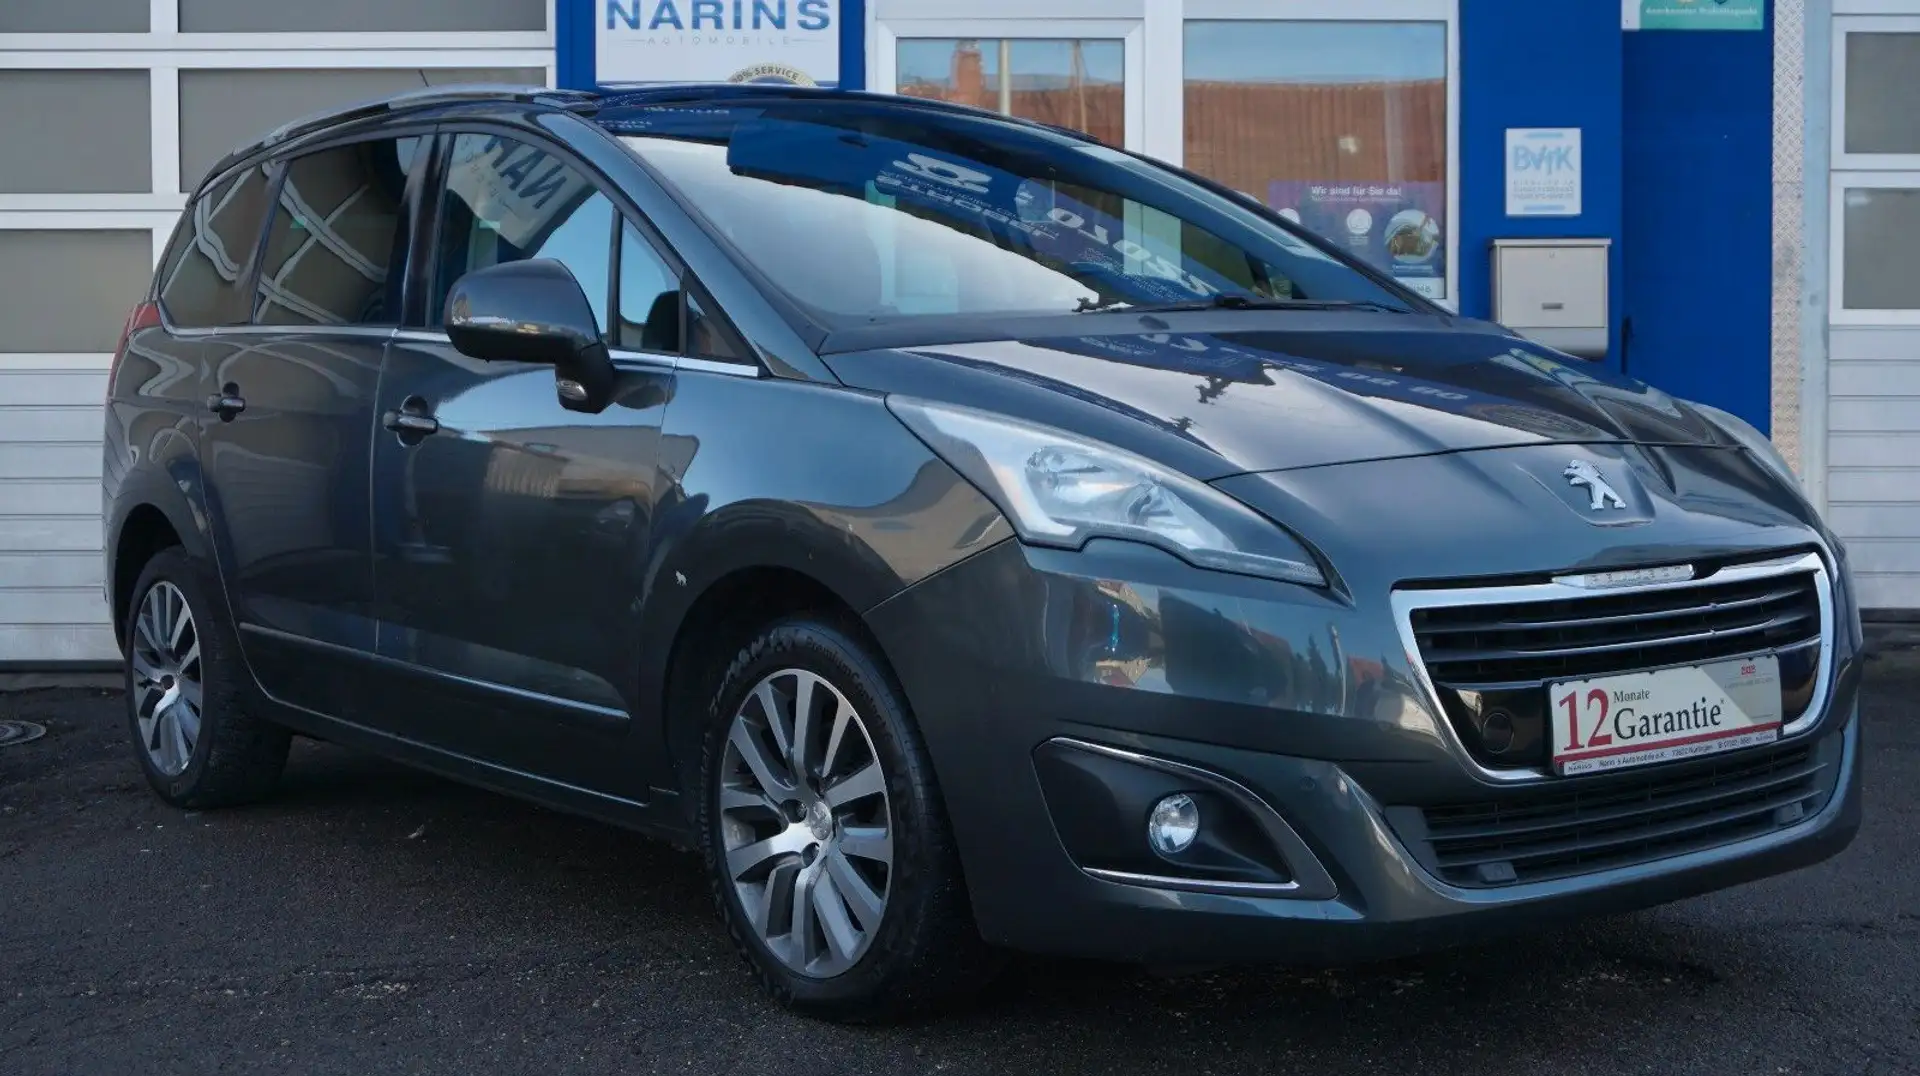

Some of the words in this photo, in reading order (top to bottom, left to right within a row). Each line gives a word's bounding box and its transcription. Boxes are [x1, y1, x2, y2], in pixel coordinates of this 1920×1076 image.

[606, 0, 831, 30] NARINS
[647, 36, 791, 46] AUTOMOBILE
[755, 66, 799, 81] SERVICE
[1558, 688, 1613, 752] 12
[1613, 688, 1651, 705] Monate
[1613, 696, 1723, 741] Garantie
